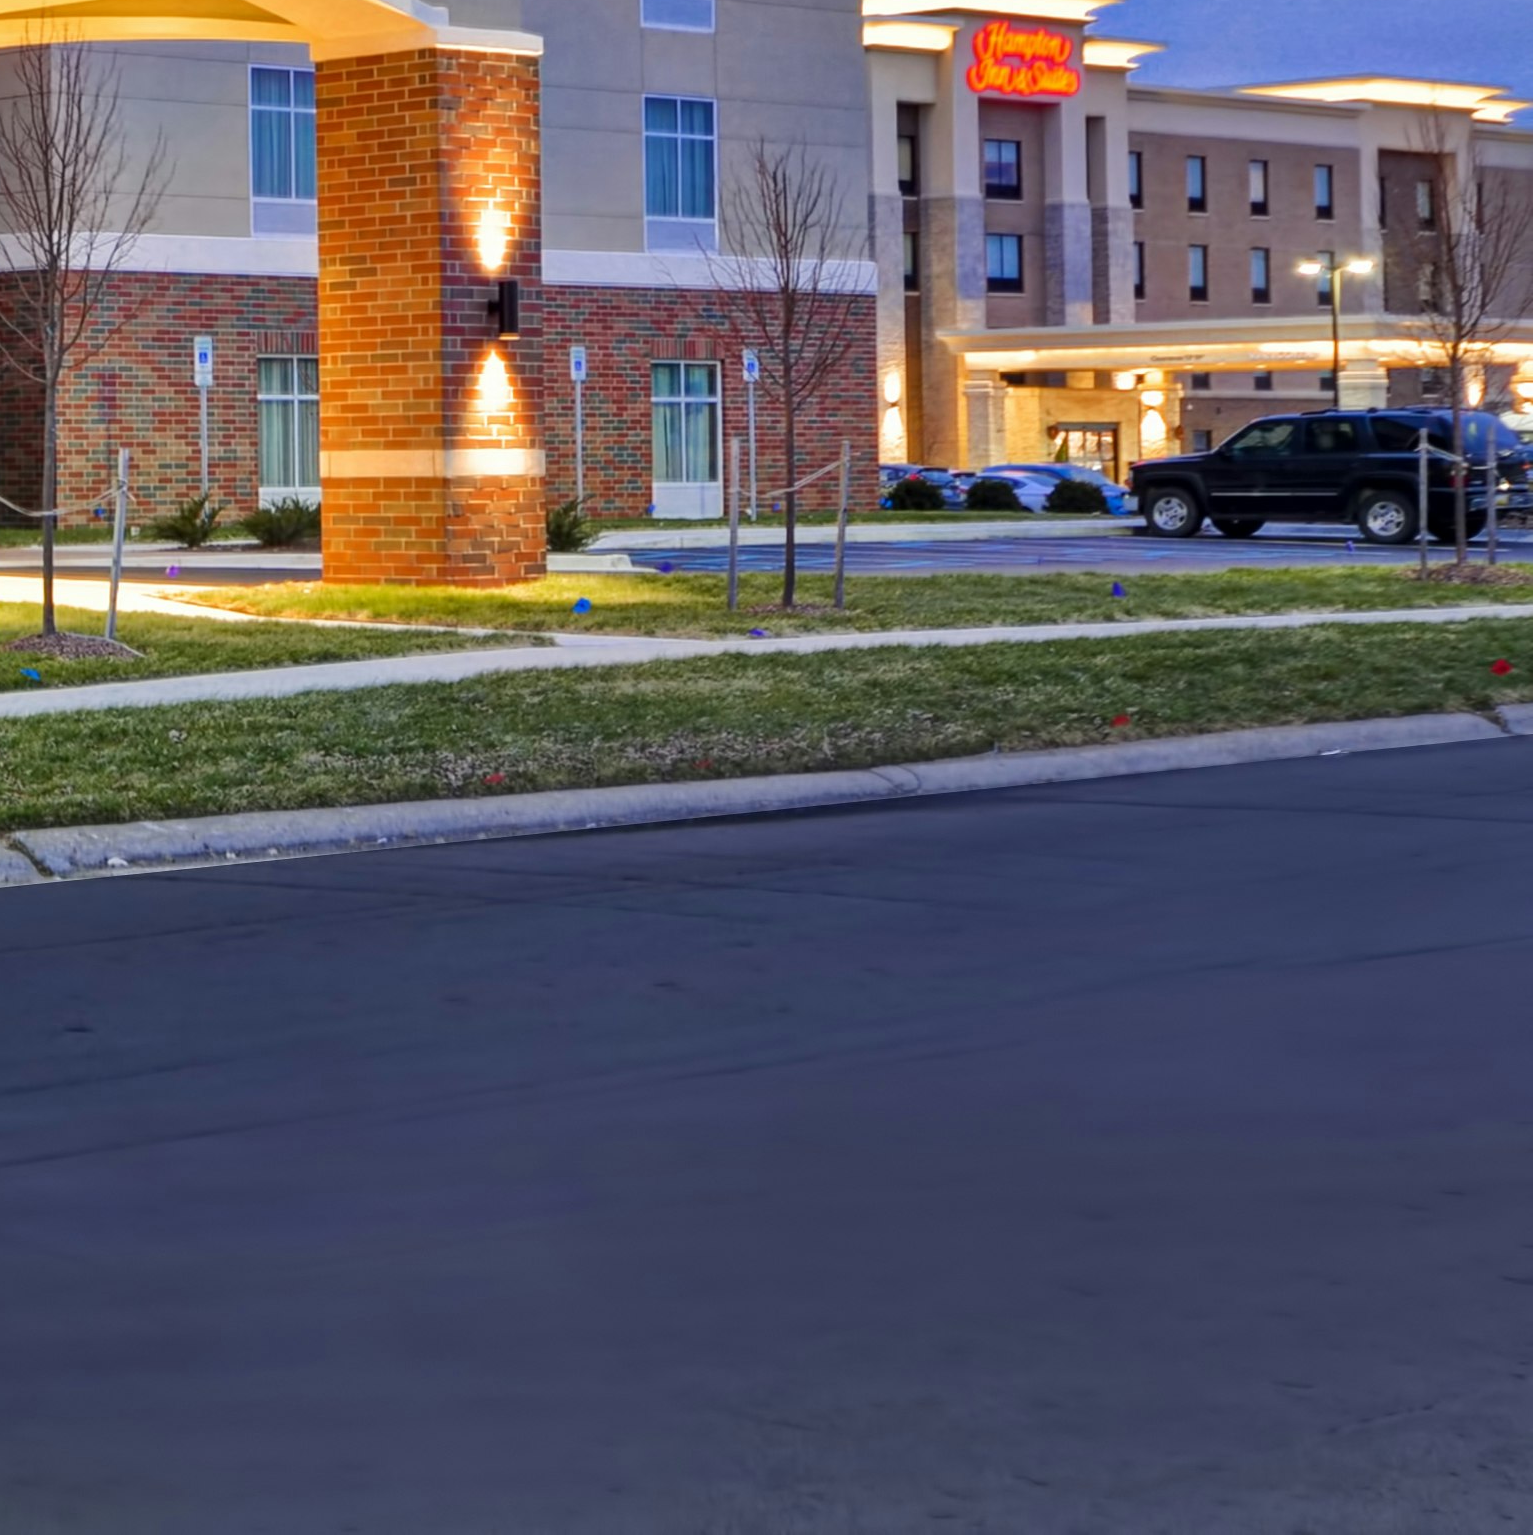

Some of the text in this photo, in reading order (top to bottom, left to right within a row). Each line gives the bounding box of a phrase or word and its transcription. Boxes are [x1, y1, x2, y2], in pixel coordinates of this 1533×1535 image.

[973, 21, 1072, 63] Hampton
[968, 58, 1014, 94] Inn
[1029, 60, 1080, 95] Suites
